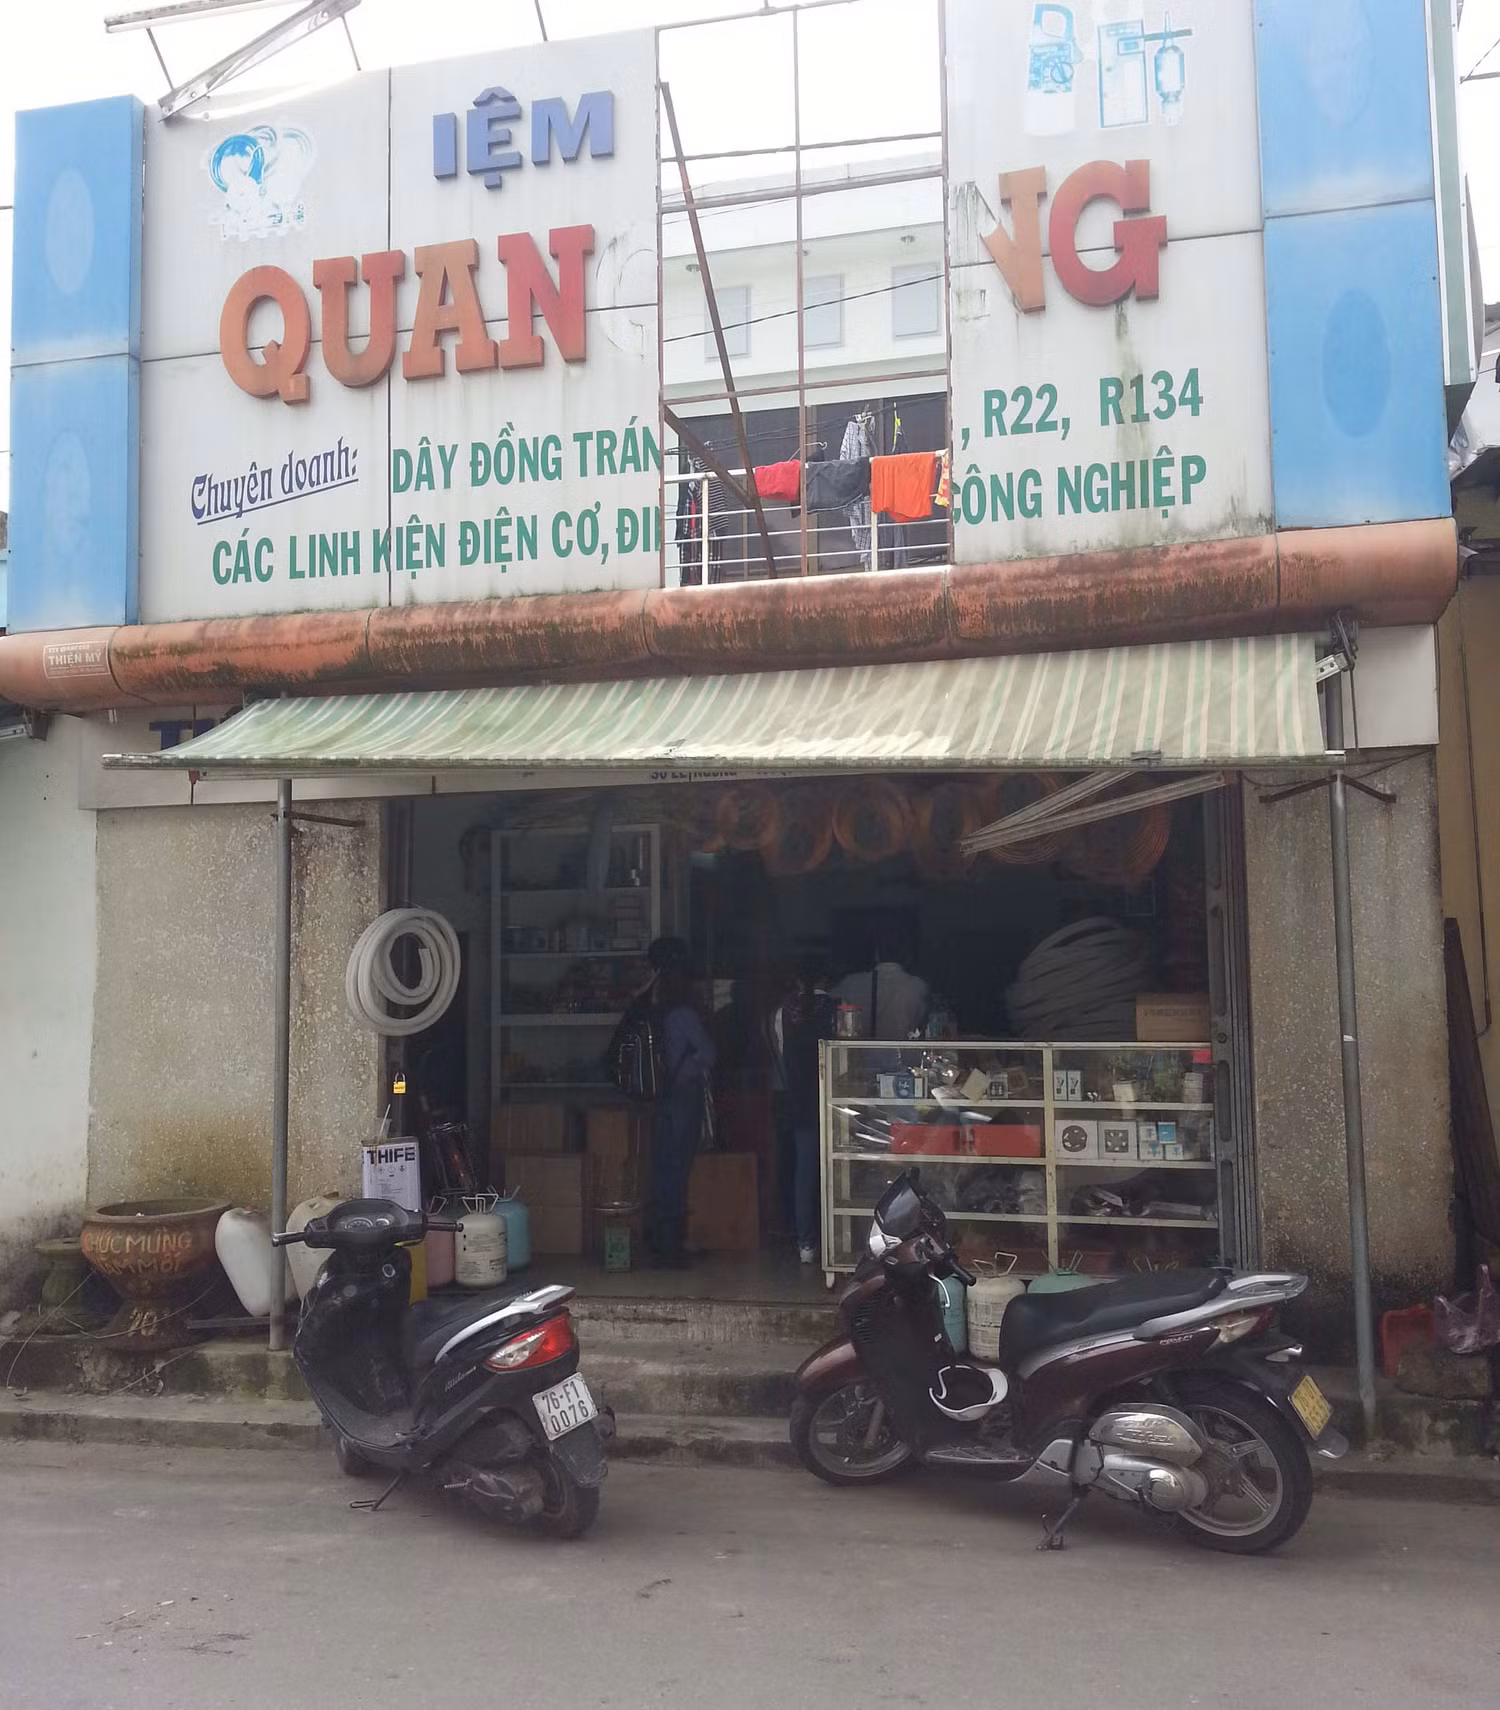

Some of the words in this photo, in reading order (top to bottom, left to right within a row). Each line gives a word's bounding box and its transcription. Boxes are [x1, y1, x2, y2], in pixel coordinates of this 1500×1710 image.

[433, 86, 614, 190] IỆM
[220, 224, 595, 404] QUAN
[984, 383, 1071, 441] R22,
[1100, 368, 1203, 427] R134
[191, 461, 273, 520] Chuyên
[281, 436, 358, 495] doanh:
[392, 436, 459, 494] DÂY
[470, 422, 562, 487] ĐỒNG
[1057, 445, 1207, 519] NGHIỆP
[212, 527, 274, 586] CÁC
[288, 531, 360, 580] LINH
[373, 513, 446, 580] KIỆN
[458, 506, 538, 573] ĐIỆN
[552, 501, 608, 565] CƠ,
[541, 1380, 581, 1414] 76-F1
[550, 1400, 590, 1434] 0076
